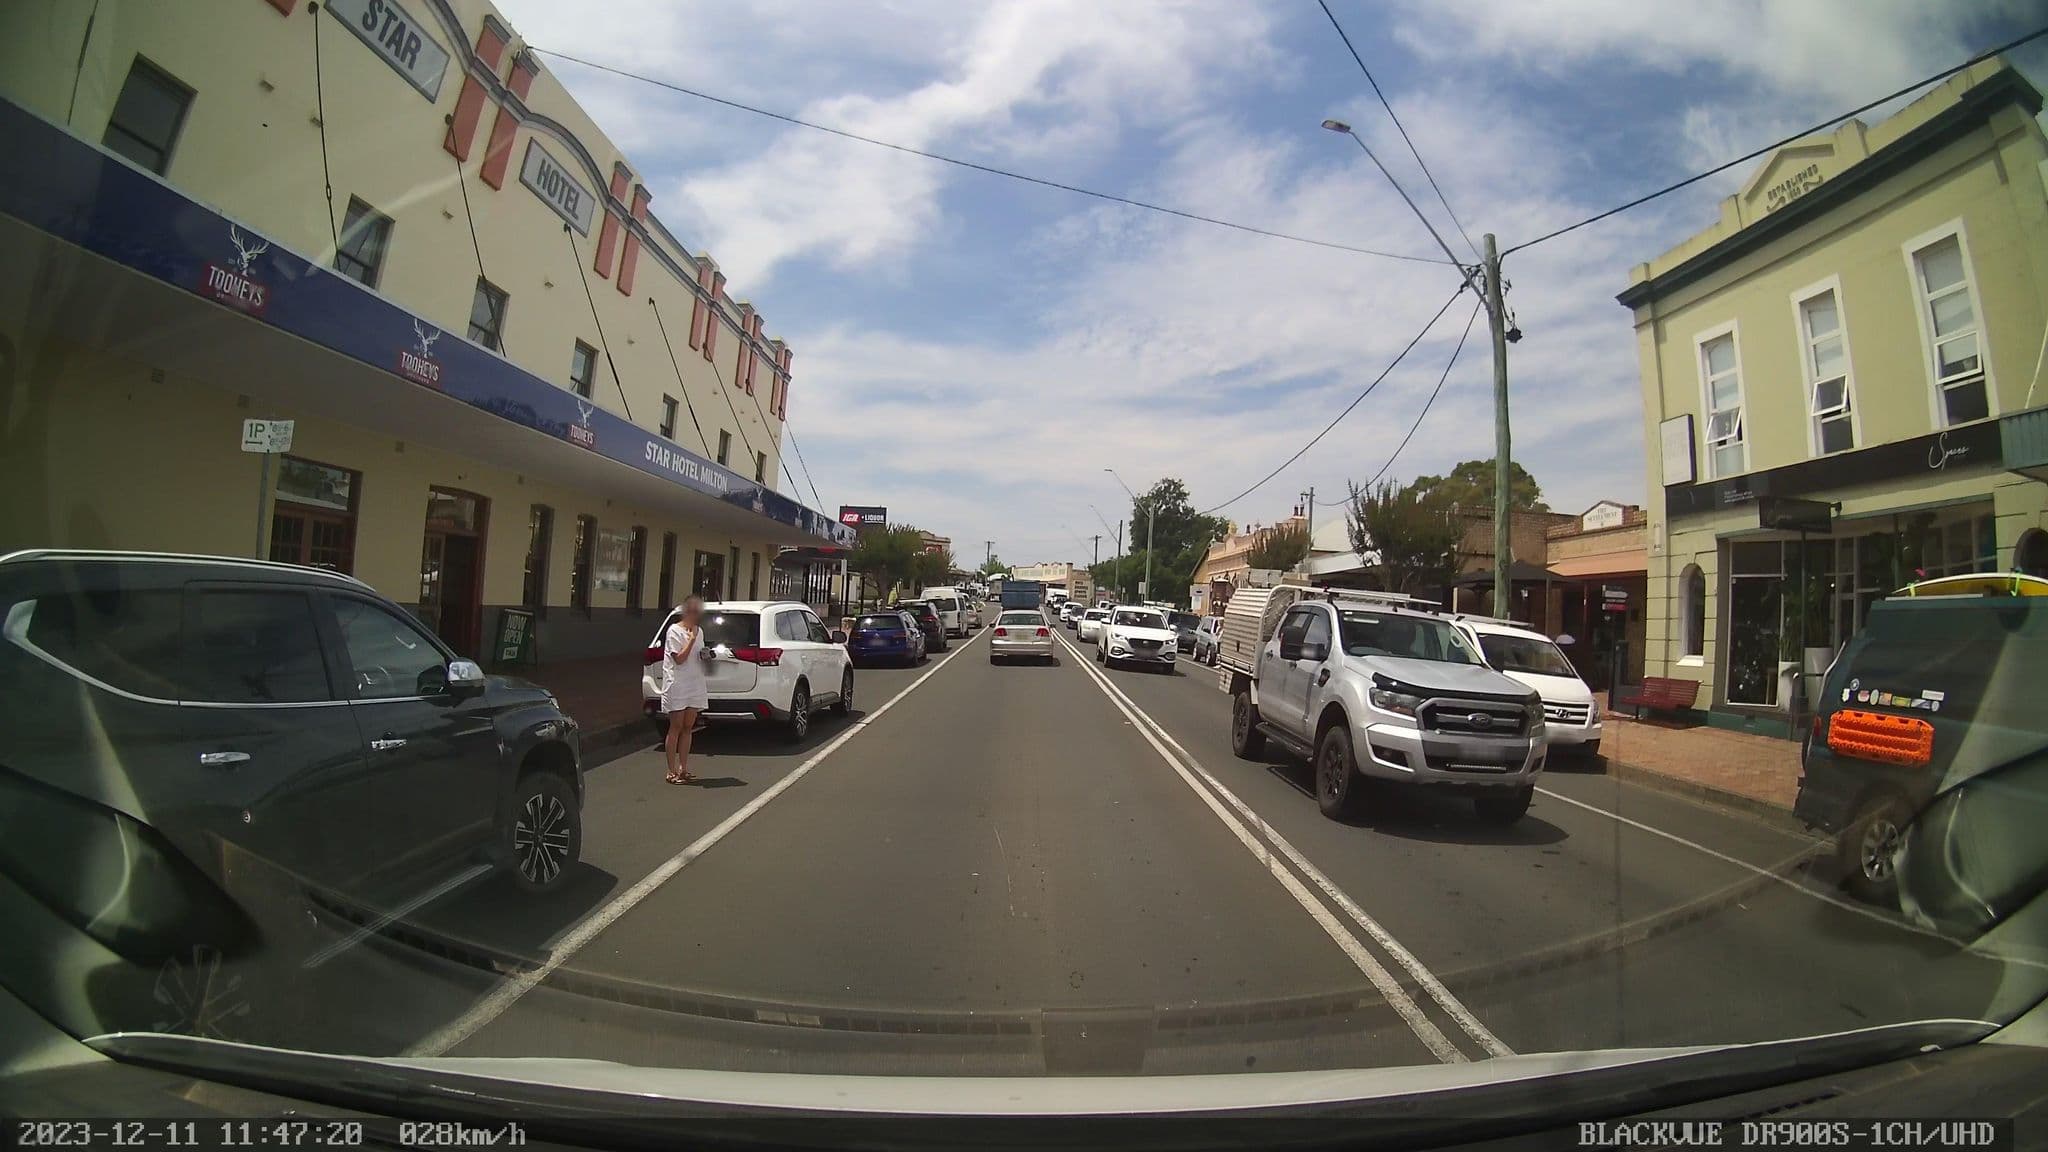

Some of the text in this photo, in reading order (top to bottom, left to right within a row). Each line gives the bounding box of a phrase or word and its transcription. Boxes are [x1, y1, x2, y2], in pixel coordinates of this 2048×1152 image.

[362, 0, 422, 70] STAR
[536, 158, 579, 220] HOTEL
[1767, 164, 1818, 201] ESTABLISHED
[208, 265, 263, 306] TOOHEYS
[401, 351, 439, 381] TOOHEYS
[249, 423, 265, 438] 1P
[645, 441, 728, 492] STAR HOTEL MILTON
[842, 513, 884, 522] IGA LIQUOR
[504, 628, 523, 645] OPEN
[507, 614, 527, 631] NOW
